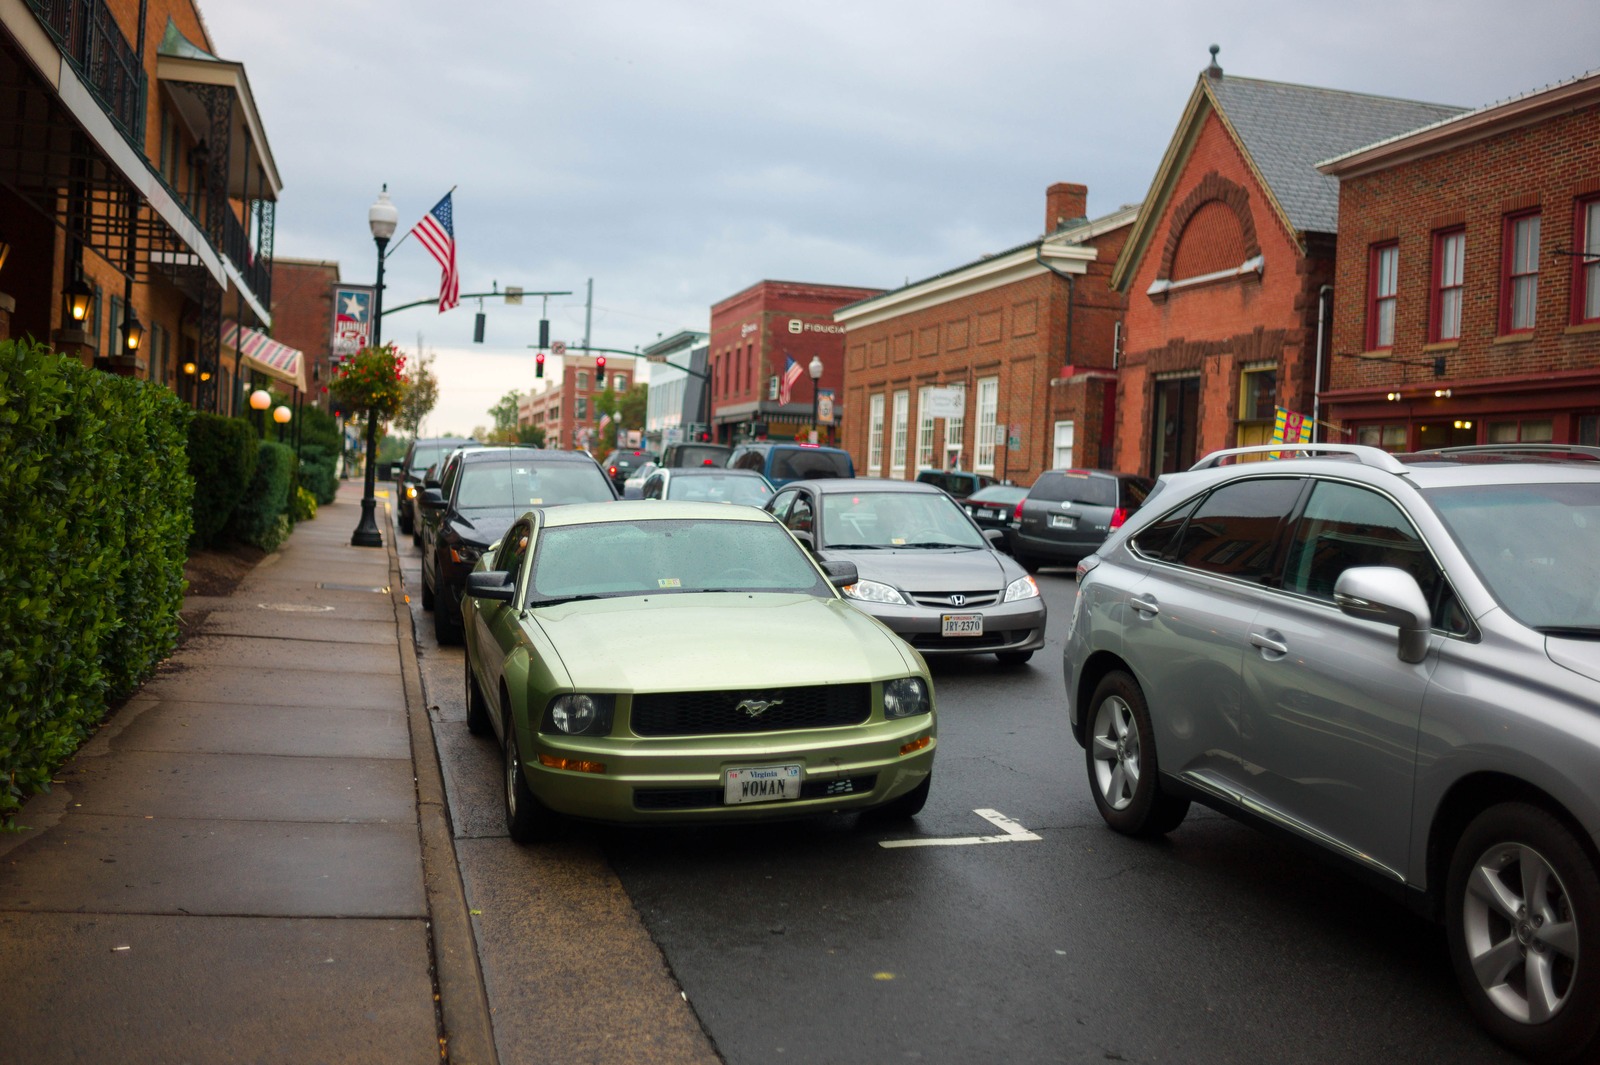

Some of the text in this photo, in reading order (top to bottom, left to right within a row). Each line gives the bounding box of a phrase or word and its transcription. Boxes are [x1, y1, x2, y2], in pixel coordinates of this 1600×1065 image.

[945, 621, 980, 631] JRY-2370
[750, 771, 778, 779] Virginia
[741, 779, 785, 797] WOMAN
